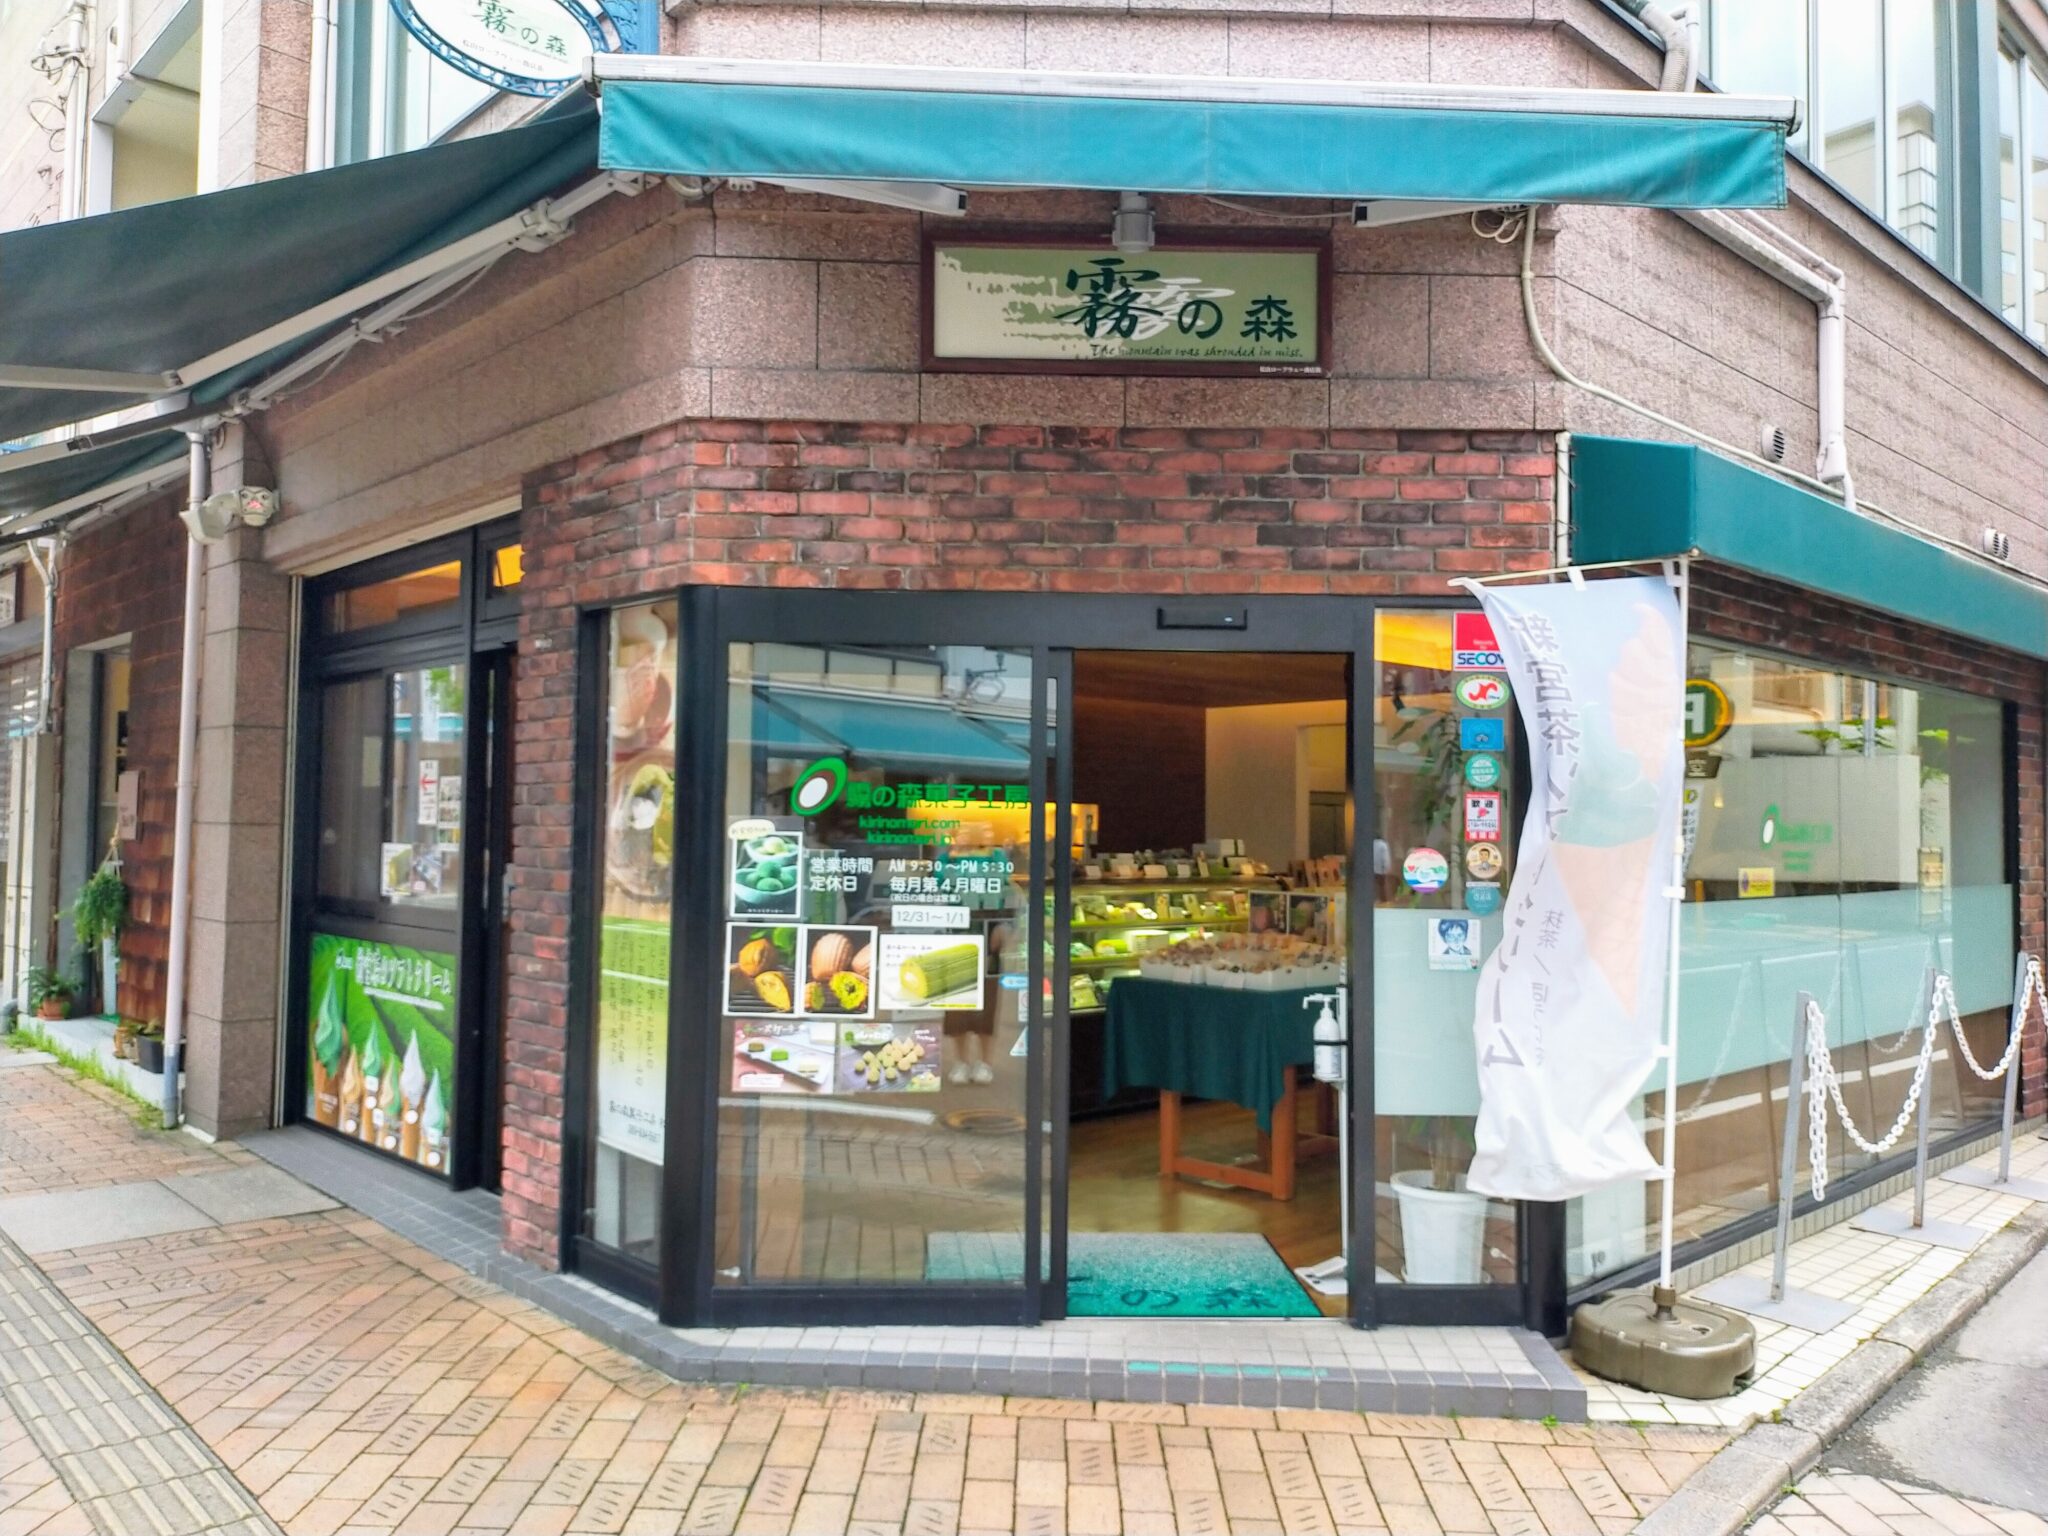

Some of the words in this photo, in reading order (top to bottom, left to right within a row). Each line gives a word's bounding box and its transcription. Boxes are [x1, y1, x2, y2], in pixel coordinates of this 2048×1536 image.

[472, 0, 567, 56] 霧の森
[1053, 257, 1298, 343] 霧の森
[1090, 343, 1115, 357] The
[1119, 345, 1171, 357] mountain
[1175, 348, 1200, 357] was
[1204, 346, 1255, 357] shrouded
[1259, 346, 1271, 357] in
[809, 857, 873, 874] 営業時間
[888, 859, 906, 872] AM
[909, 859, 942, 872] 9:30
[982, 860, 1015, 874] 5:30
[808, 875, 858, 892] 定休日
